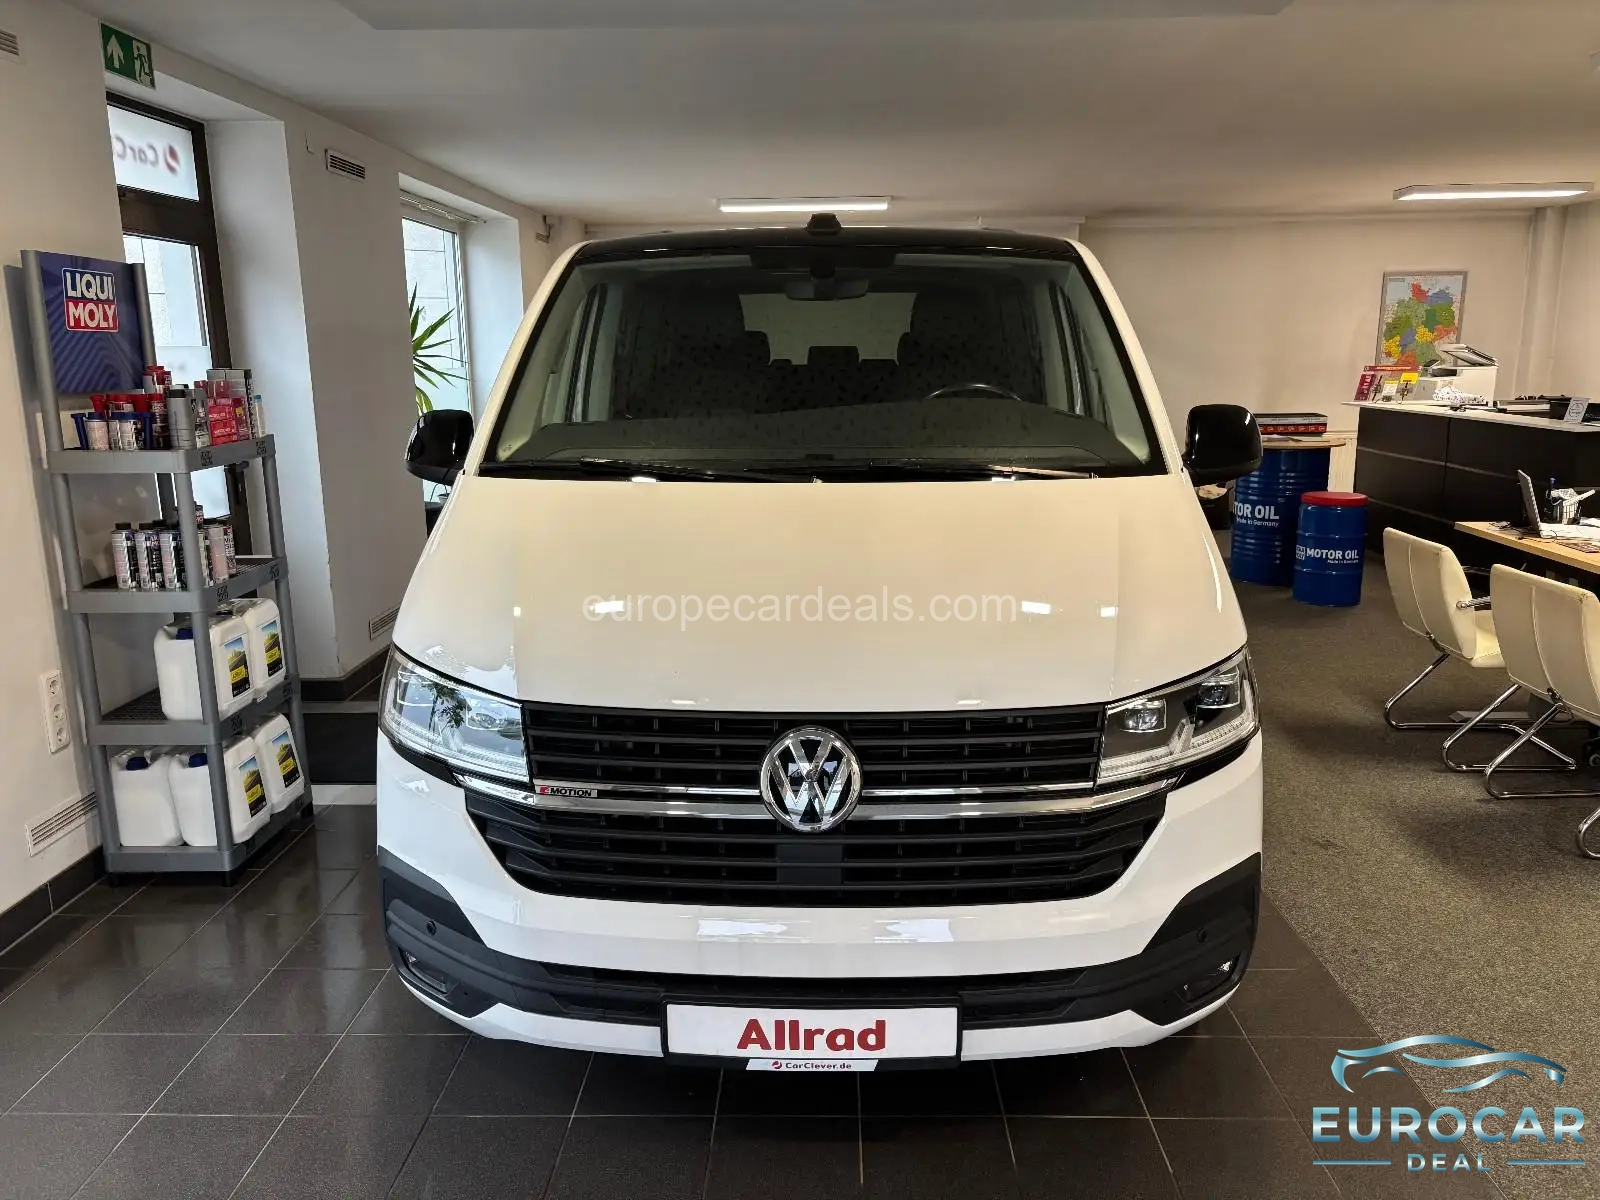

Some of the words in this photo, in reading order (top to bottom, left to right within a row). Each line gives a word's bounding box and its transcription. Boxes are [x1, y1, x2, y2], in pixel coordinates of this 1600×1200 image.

[66, 272, 113, 300] LIQUI
[68, 302, 115, 328] MOLY
[1254, 505, 1279, 519] OIL
[1306, 547, 1342, 560] MOTOR
[1344, 549, 1359, 560] OIL
[736, 1018, 886, 1051] Allrad
[785, 1061, 852, 1070] CarClever.de
